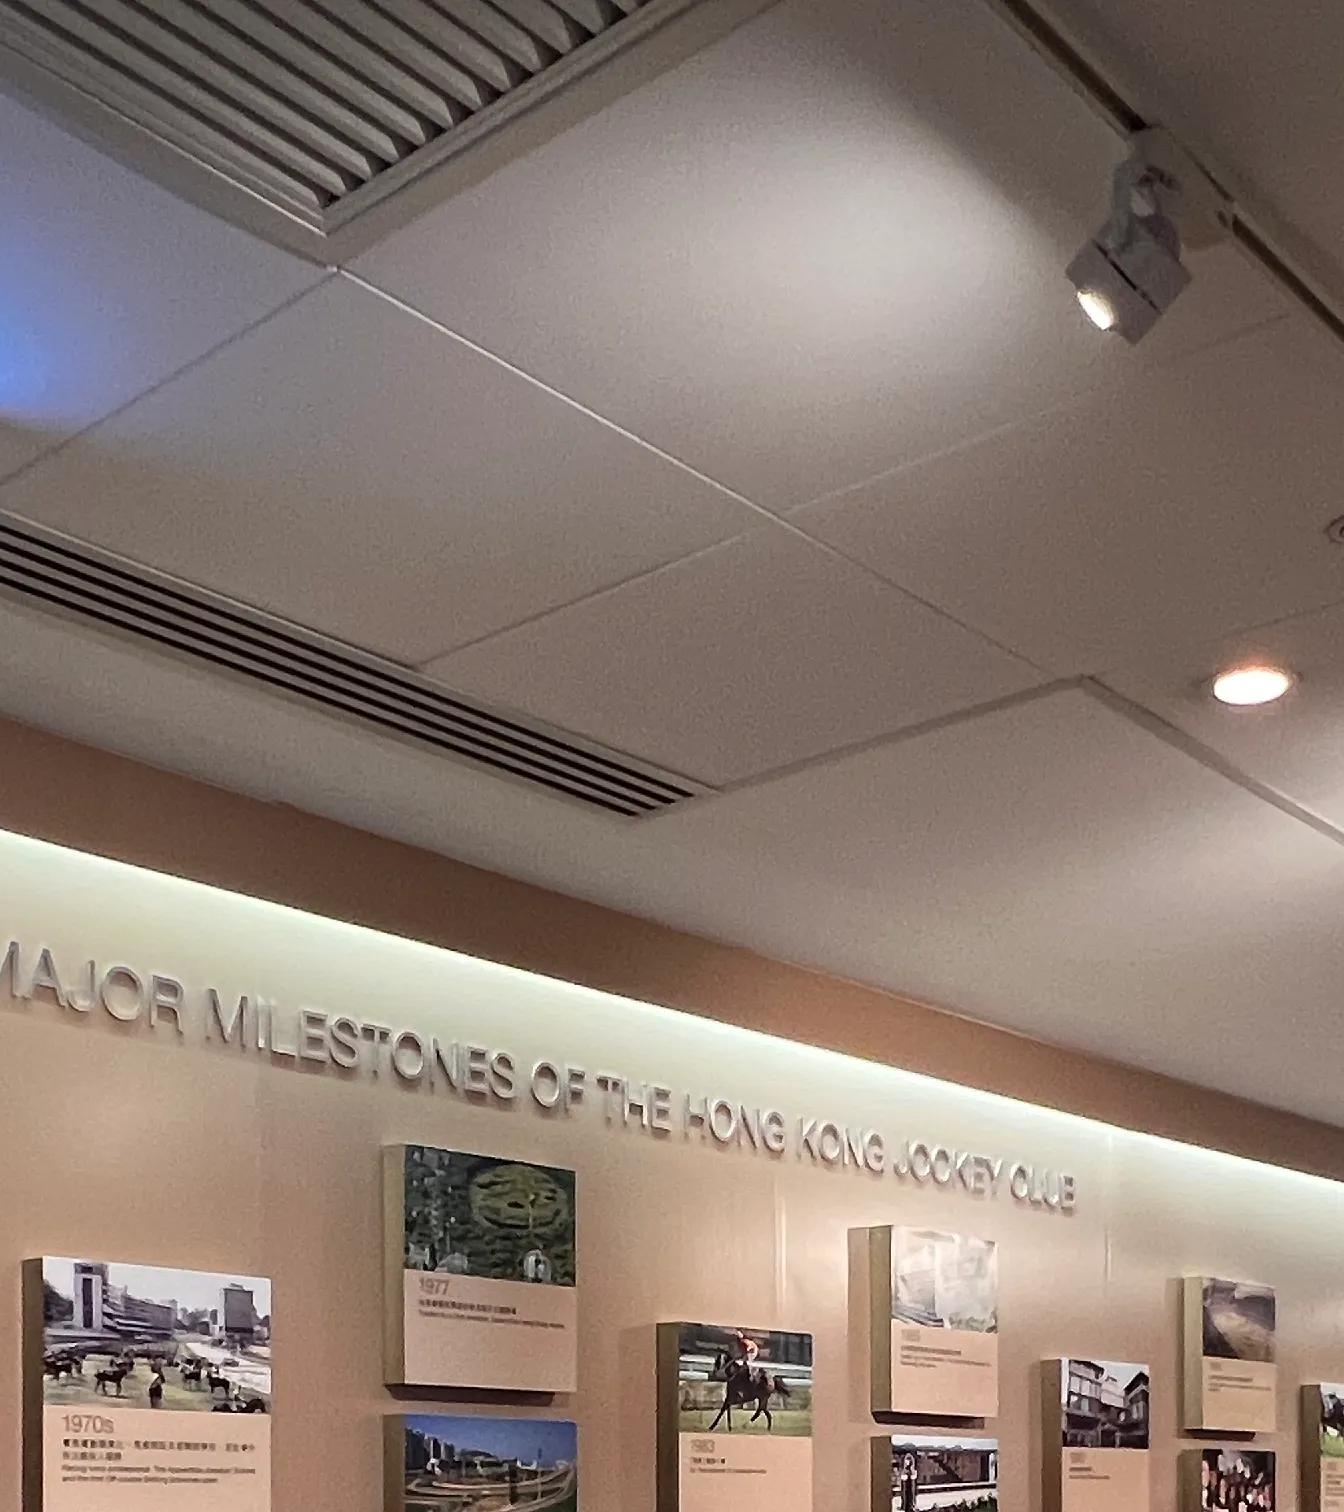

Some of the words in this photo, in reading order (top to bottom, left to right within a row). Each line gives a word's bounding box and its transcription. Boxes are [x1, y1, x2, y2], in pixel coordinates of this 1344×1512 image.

[206, 987, 516, 1100] MILESTONES
[531, 1061, 586, 1117] OF
[596, 1075, 671, 1131] THE
[683, 1093, 785, 1153] HONG
[796, 1115, 884, 1174] KONG
[894, 1141, 1003, 1196] JOCKEY
[1009, 1164, 1076, 1212] CLUB
[62, 1413, 115, 1434] 1970s
